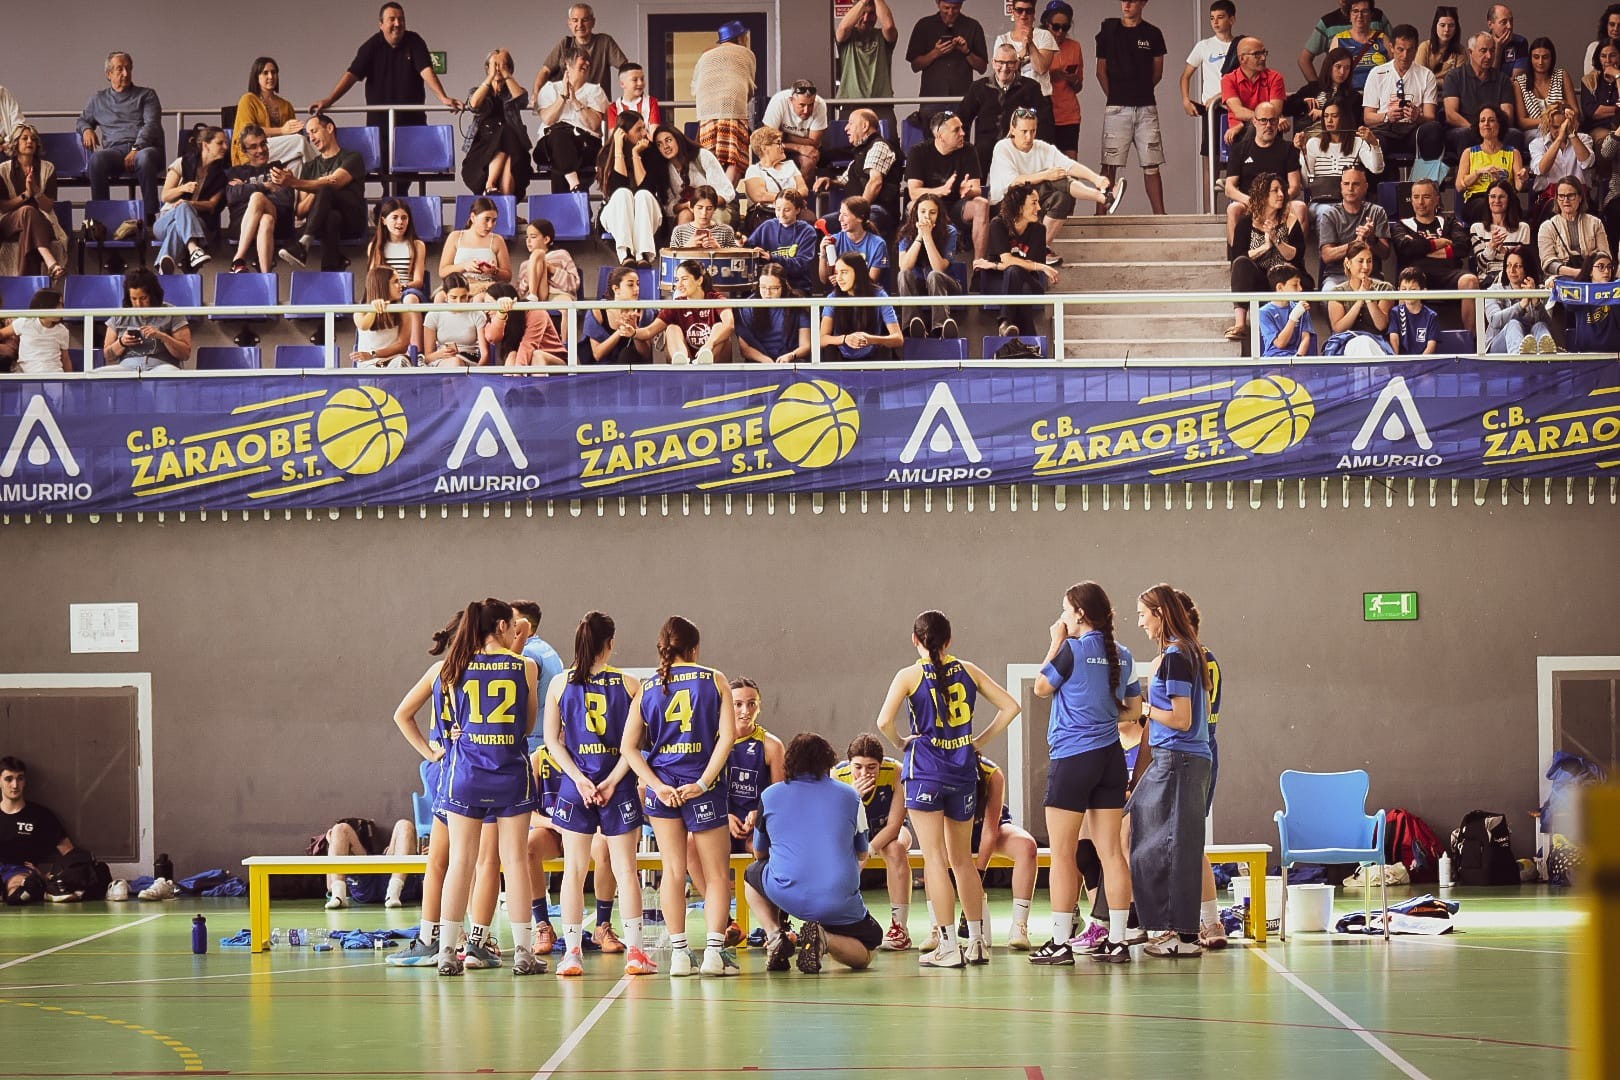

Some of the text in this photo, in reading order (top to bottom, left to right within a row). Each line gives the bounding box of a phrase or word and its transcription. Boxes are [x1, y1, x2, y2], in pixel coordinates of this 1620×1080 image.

[1031, 416, 1081, 442] C.B.
[1482, 406, 1531, 430] C.B.
[127, 426, 175, 453] C.B.
[576, 419, 625, 446] C.B.
[1033, 411, 1219, 470] ZARAOBE
[130, 422, 312, 487] ZARAOBE
[580, 417, 763, 478] ZARAOBE
[1184, 438, 1225, 461] S.T.
[281, 455, 323, 482] S.T.
[731, 448, 772, 474] S.T.
[1336, 454, 1443, 470] AMURRIO
[0, 483, 92, 502] MURRIO
[434, 474, 540, 494] AMURRIO
[467, 661, 523, 671] ZARAOBE ST
[655, 671, 698, 686] ZAOBE
[699, 671, 712, 680] ST
[462, 679, 517, 723] 12
[585, 692, 608, 736] 8
[665, 689, 694, 733] 4
[746, 742, 757, 753] Z
[16, 821, 34, 832] TG
